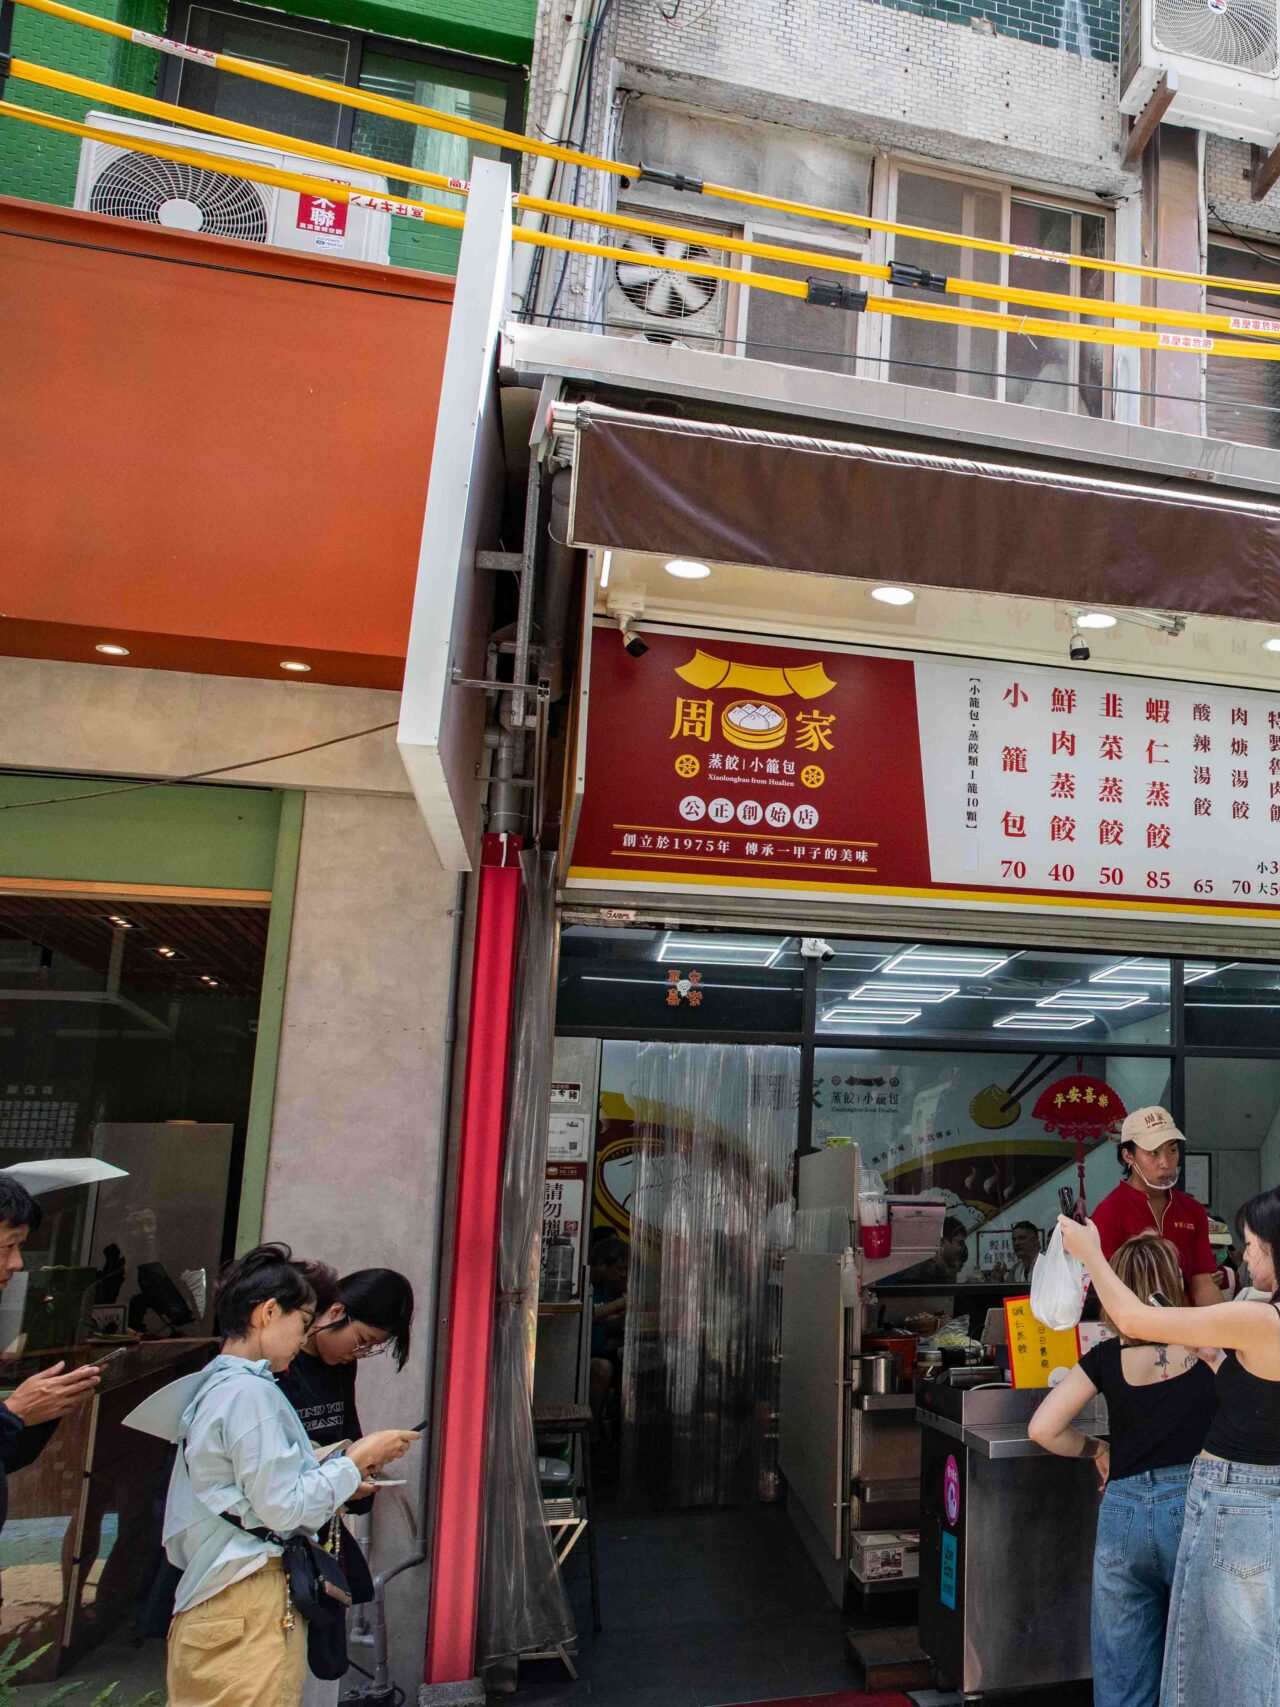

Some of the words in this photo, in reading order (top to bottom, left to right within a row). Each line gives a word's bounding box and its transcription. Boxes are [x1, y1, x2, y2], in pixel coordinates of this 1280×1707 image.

[1000, 682, 1029, 839] 小籠包
[1050, 687, 1077, 842] 鮮肉蒸餃
[1098, 692, 1124, 847] 韭菜蒸餃
[1192, 703, 1212, 817] 酸辣湯餃
[707, 774, 750, 784] Xiaolongbao
[750, 777, 768, 786] from
[769, 779, 795, 788] Hualien
[1145, 697, 1171, 850] 蝦仁蒸餃
[683, 799, 816, 826] 公正創始店
[622, 833, 731, 854] 創立於1975年
[745, 842, 869, 864] 傳承一甲子的美味
[1000, 860, 1026, 879] 70
[1048, 864, 1075, 882] 40
[1099, 867, 1123, 886] 50
[1146, 871, 1171, 889] 85
[1193, 879, 1213, 894] 65
[1232, 880, 1251, 895] 70
